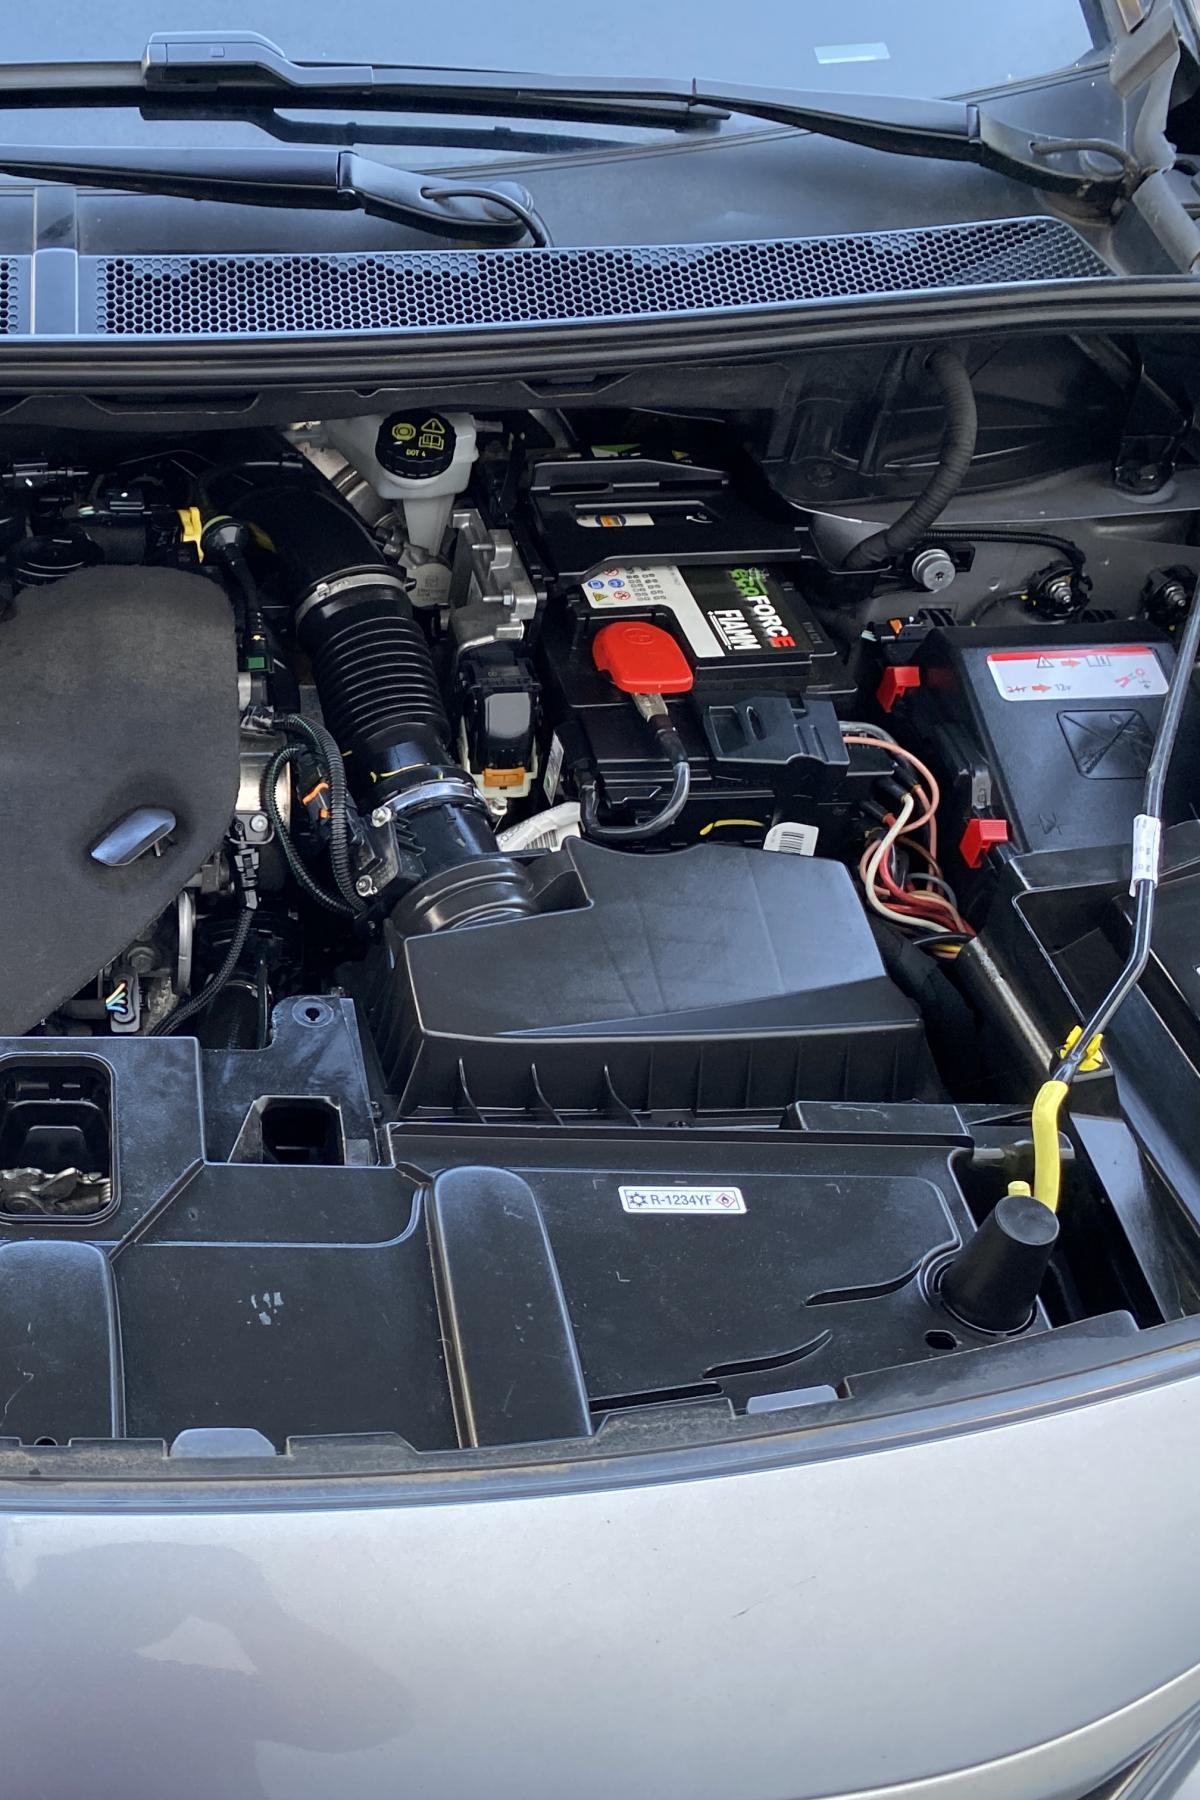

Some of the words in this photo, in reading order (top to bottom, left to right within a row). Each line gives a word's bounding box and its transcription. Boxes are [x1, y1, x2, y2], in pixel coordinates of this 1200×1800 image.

[405, 448, 419, 457] DOT
[713, 609, 762, 650] FIAMM
[650, 1194, 712, 1206] R-1234YF
